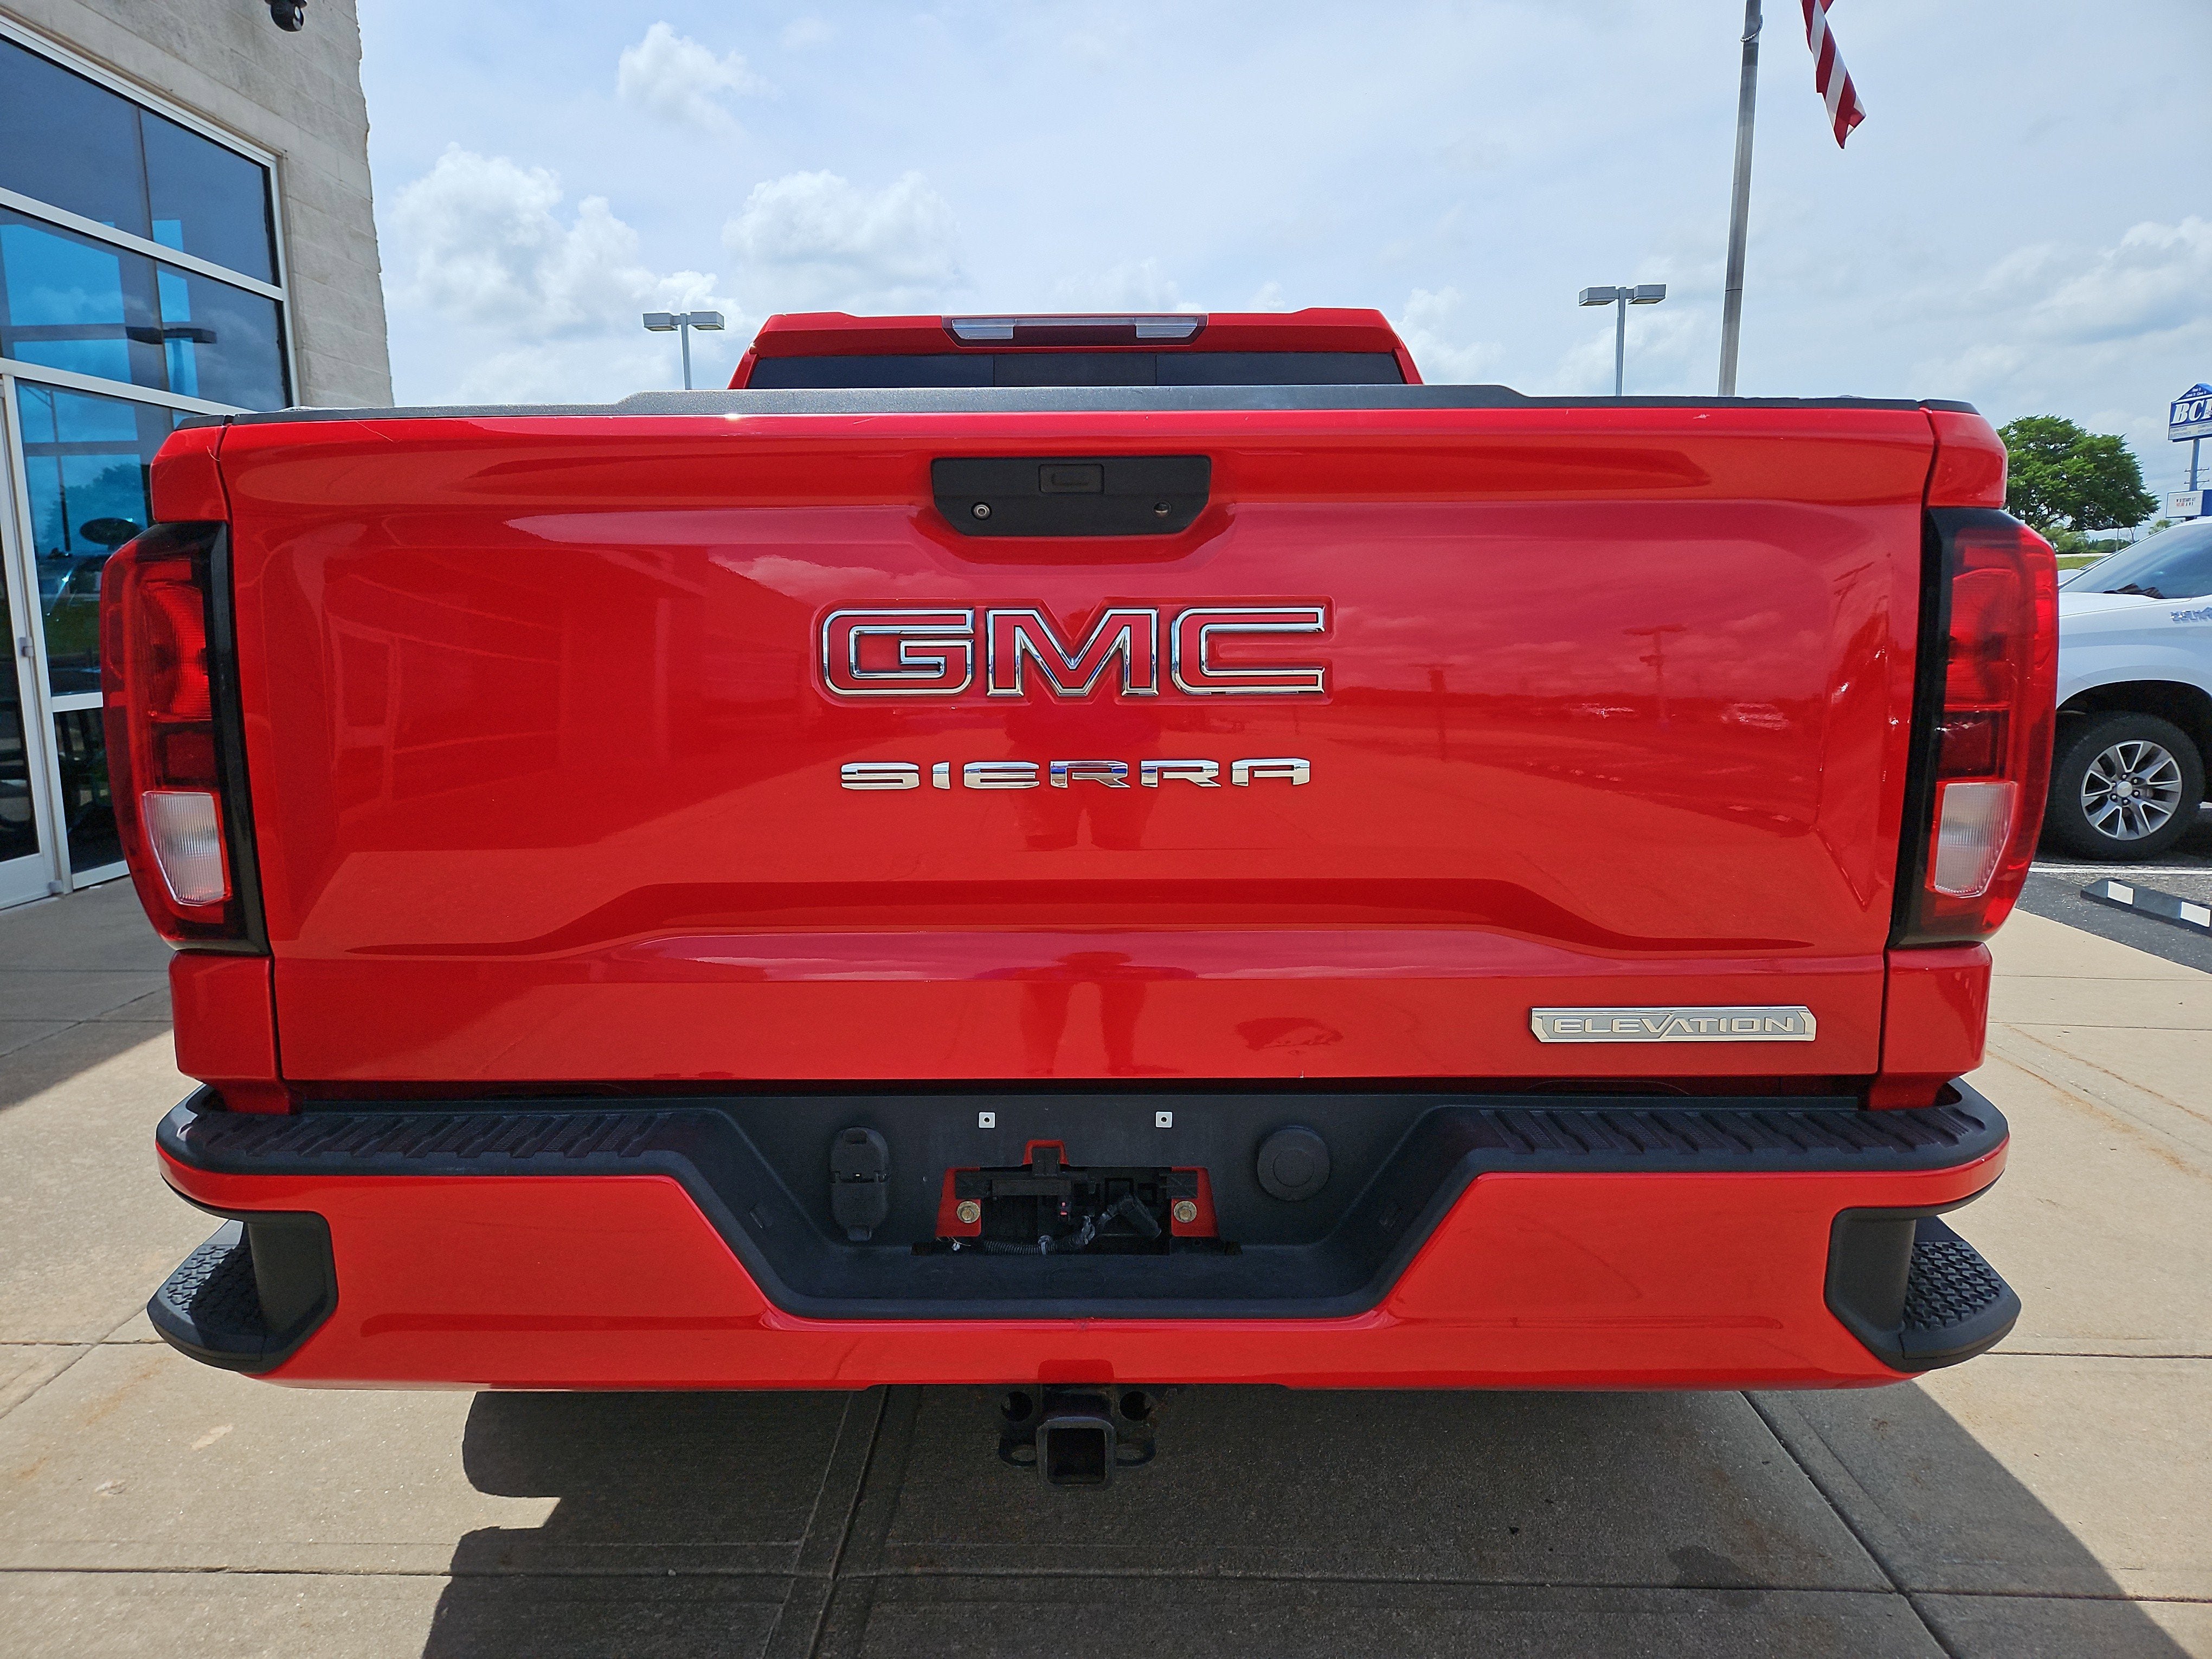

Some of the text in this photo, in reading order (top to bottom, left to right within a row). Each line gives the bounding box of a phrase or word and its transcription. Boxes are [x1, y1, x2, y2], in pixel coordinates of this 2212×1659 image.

[822, 607, 1326, 696] GMC
[841, 758, 1310, 790] SIERRA
[1553, 1017, 1795, 1033] ELEVATION
